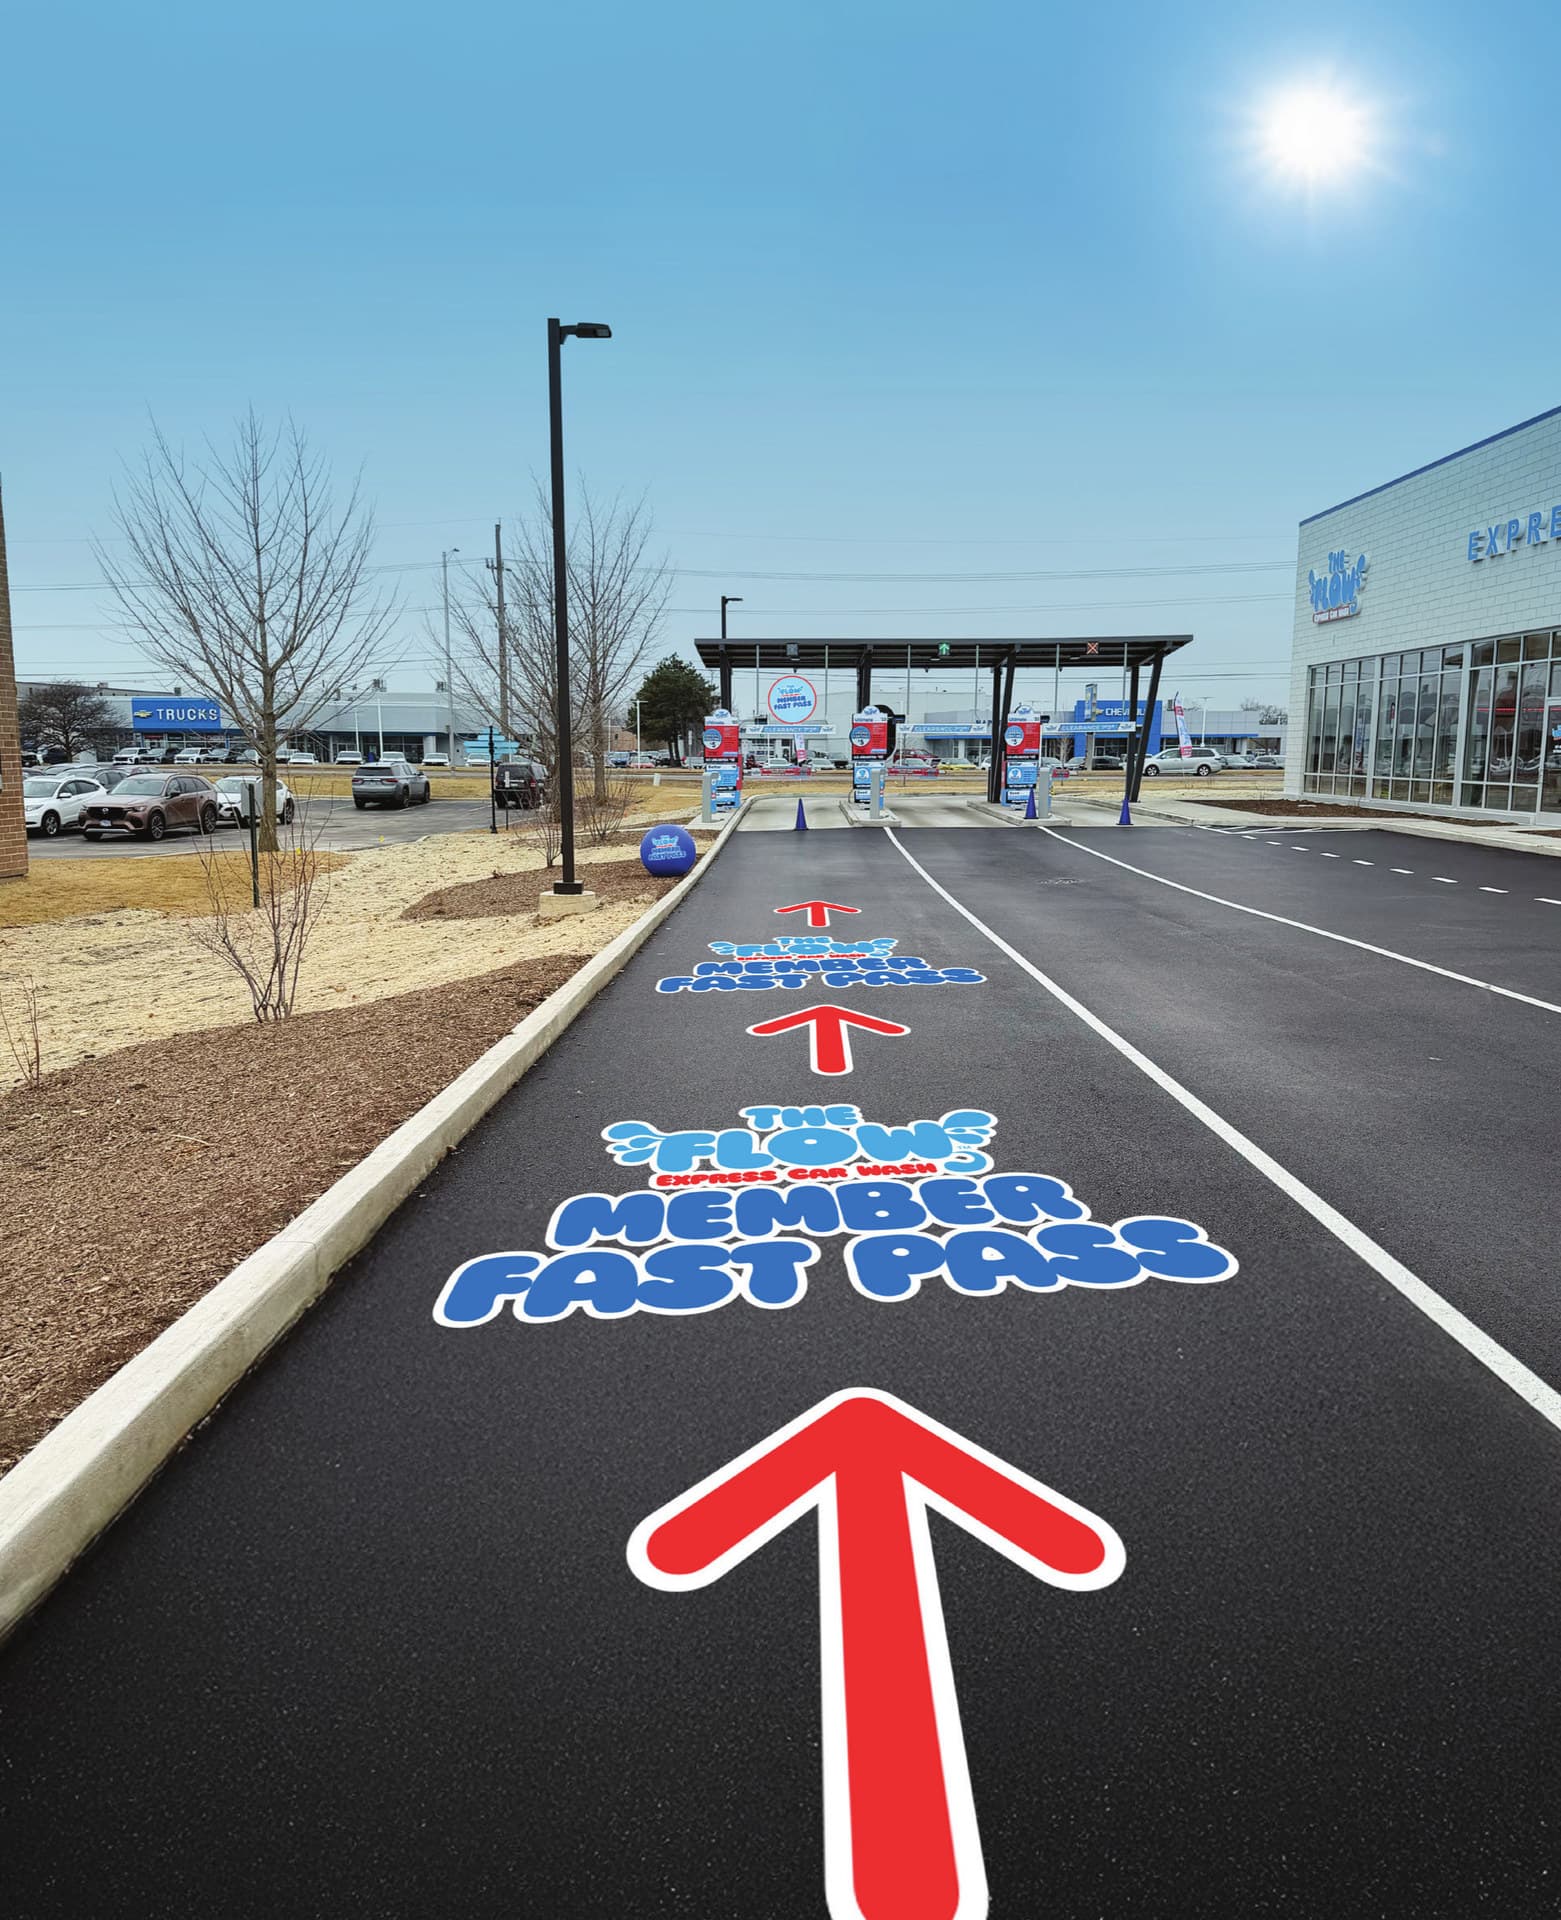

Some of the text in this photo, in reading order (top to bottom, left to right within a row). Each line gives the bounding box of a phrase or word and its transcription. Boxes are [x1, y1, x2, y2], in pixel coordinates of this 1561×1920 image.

[773, 700, 812, 710] FAST PASS
[776, 695, 806, 703] MEMBER
[156, 708, 217, 721] TRUCKS
[648, 850, 687, 861] FAST PASS
[734, 941, 877, 957] FLOW
[774, 936, 832, 945] THE
[695, 957, 929, 976] MEMBER
[657, 968, 986, 993] FAST PASS
[742, 1105, 860, 1130] THE
[654, 1120, 955, 1174] FLOW
[655, 1162, 938, 1187] EXPRESS CAR WASH
[550, 1172, 1087, 1250] MEMBER
[437, 1217, 1234, 1325] FAST PASS
